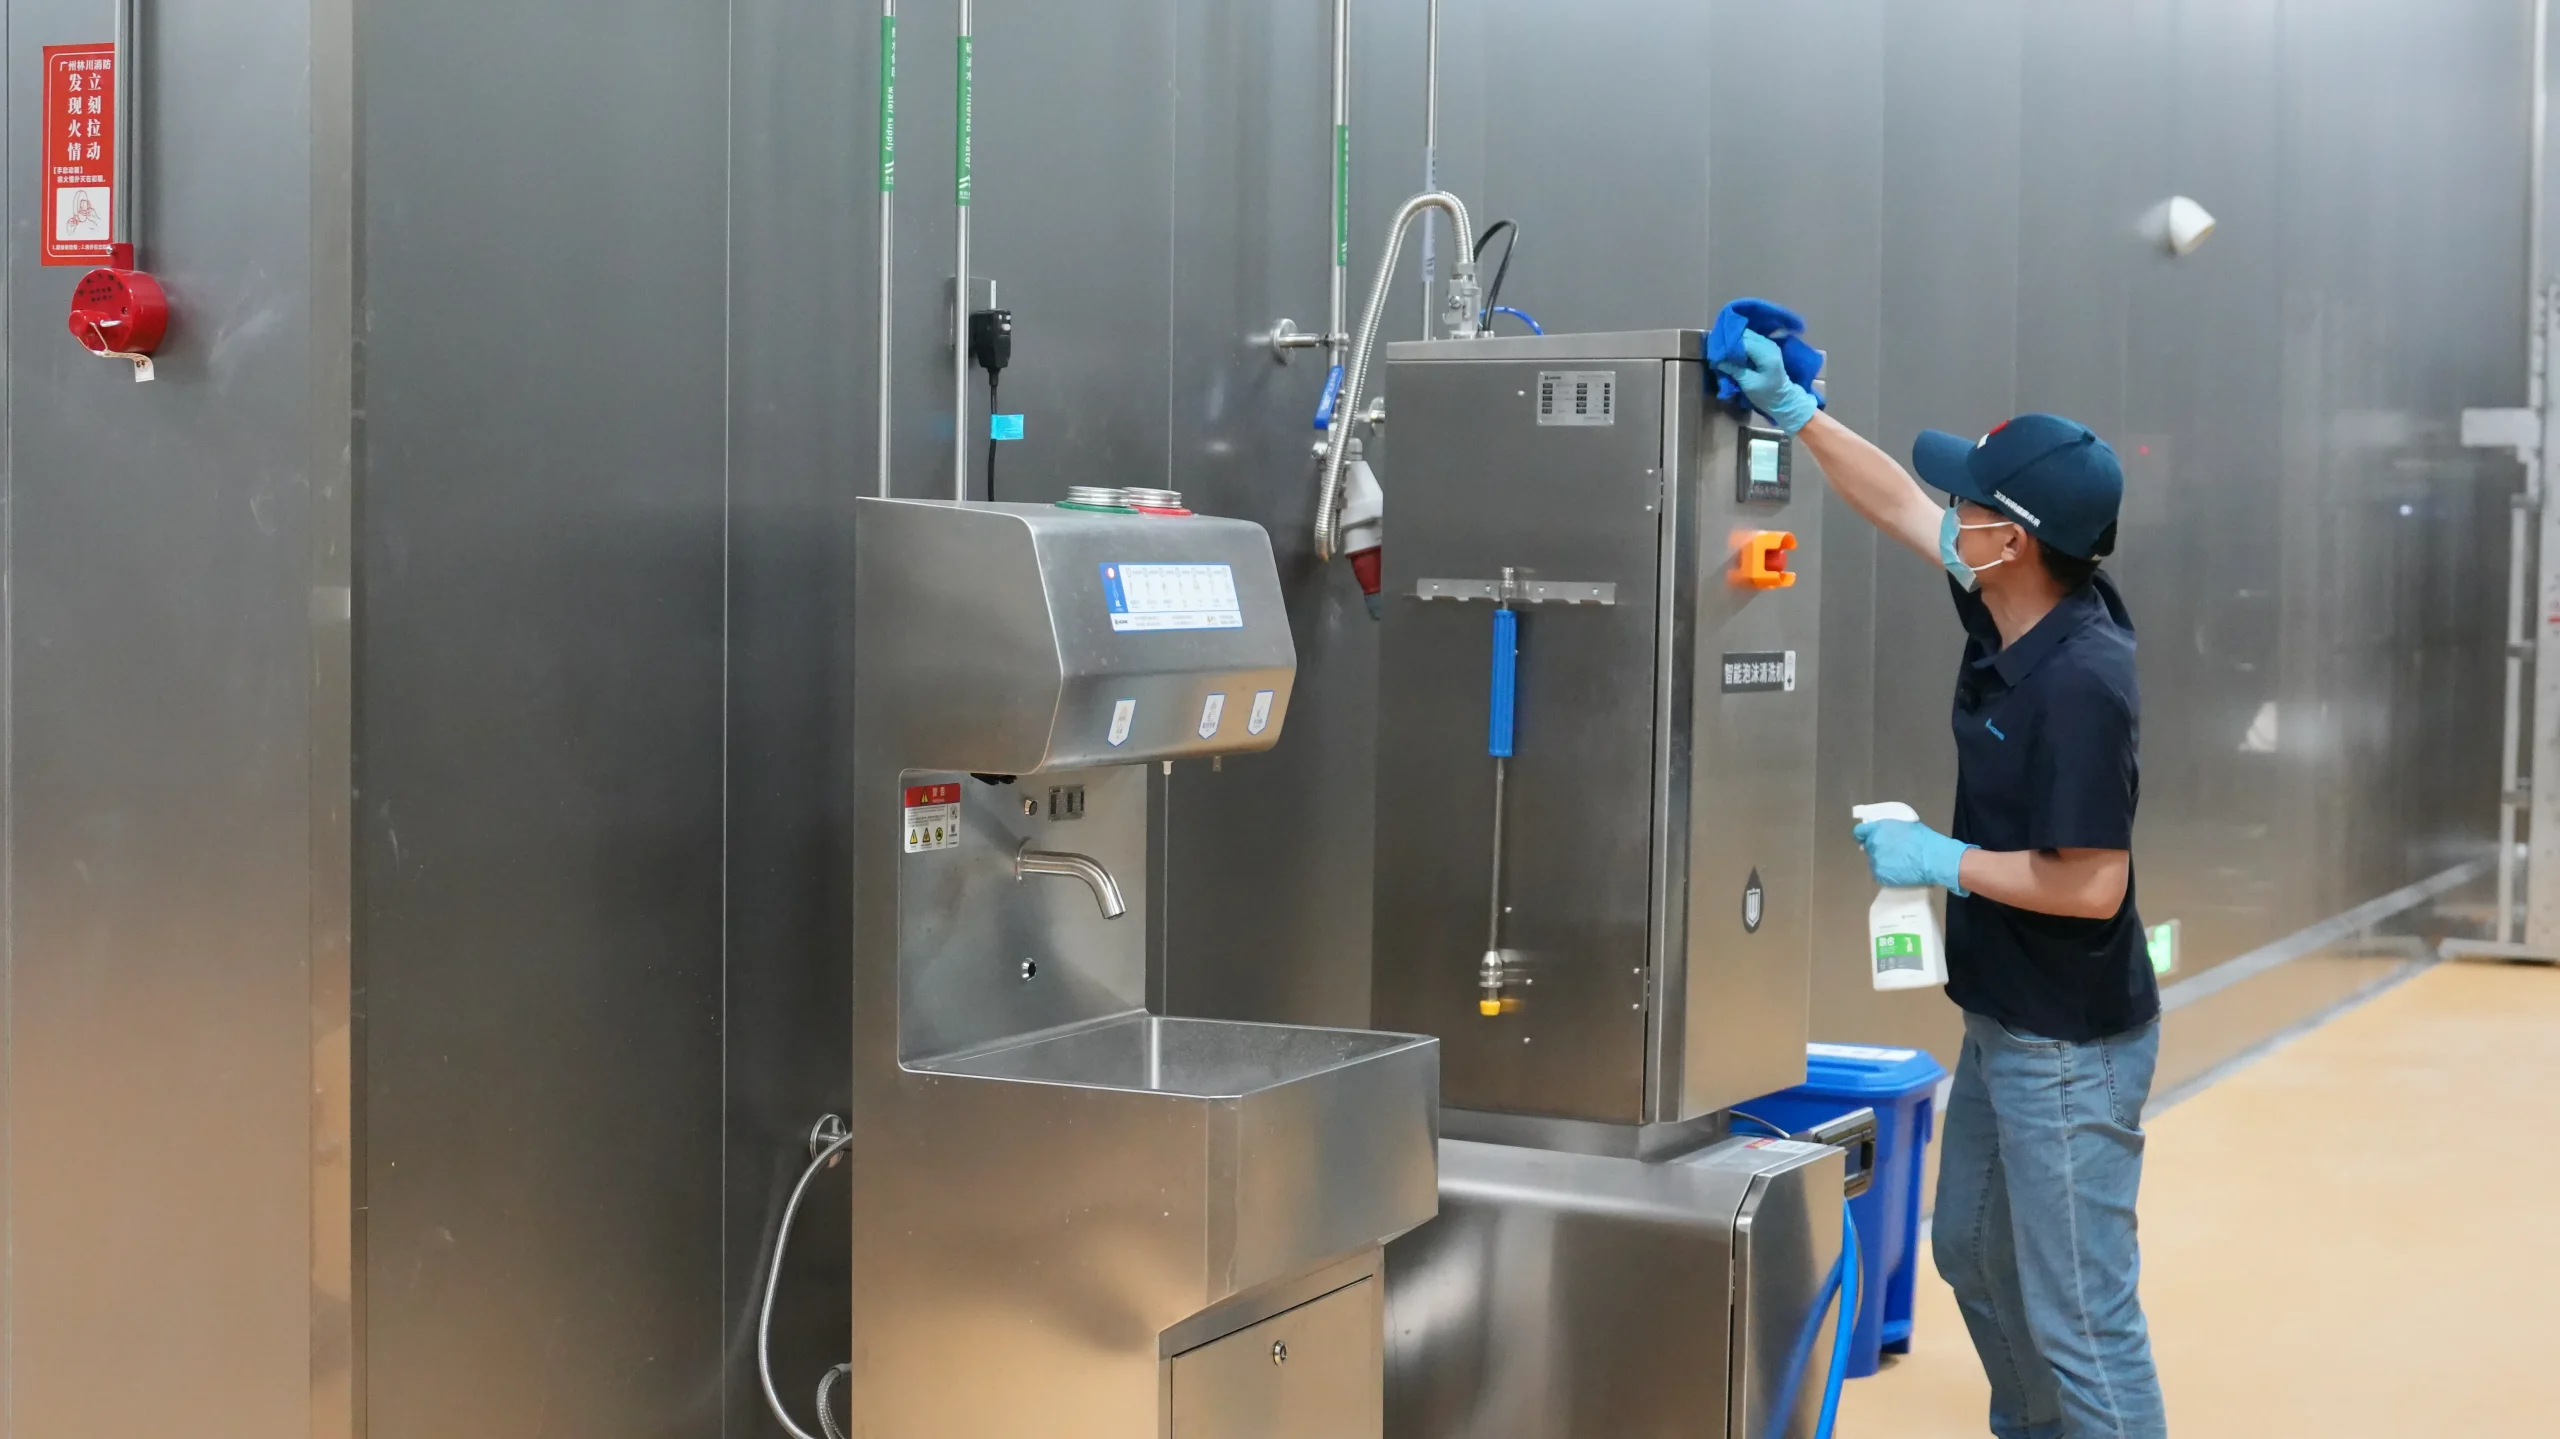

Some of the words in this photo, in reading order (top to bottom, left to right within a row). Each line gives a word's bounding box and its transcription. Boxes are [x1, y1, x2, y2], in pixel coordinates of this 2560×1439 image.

[60, 59, 111, 72] 广州林川消防
[68, 73, 83, 161] 发现火情
[86, 72, 102, 161] 立刻拉动
[885, 117, 894, 152] supply
